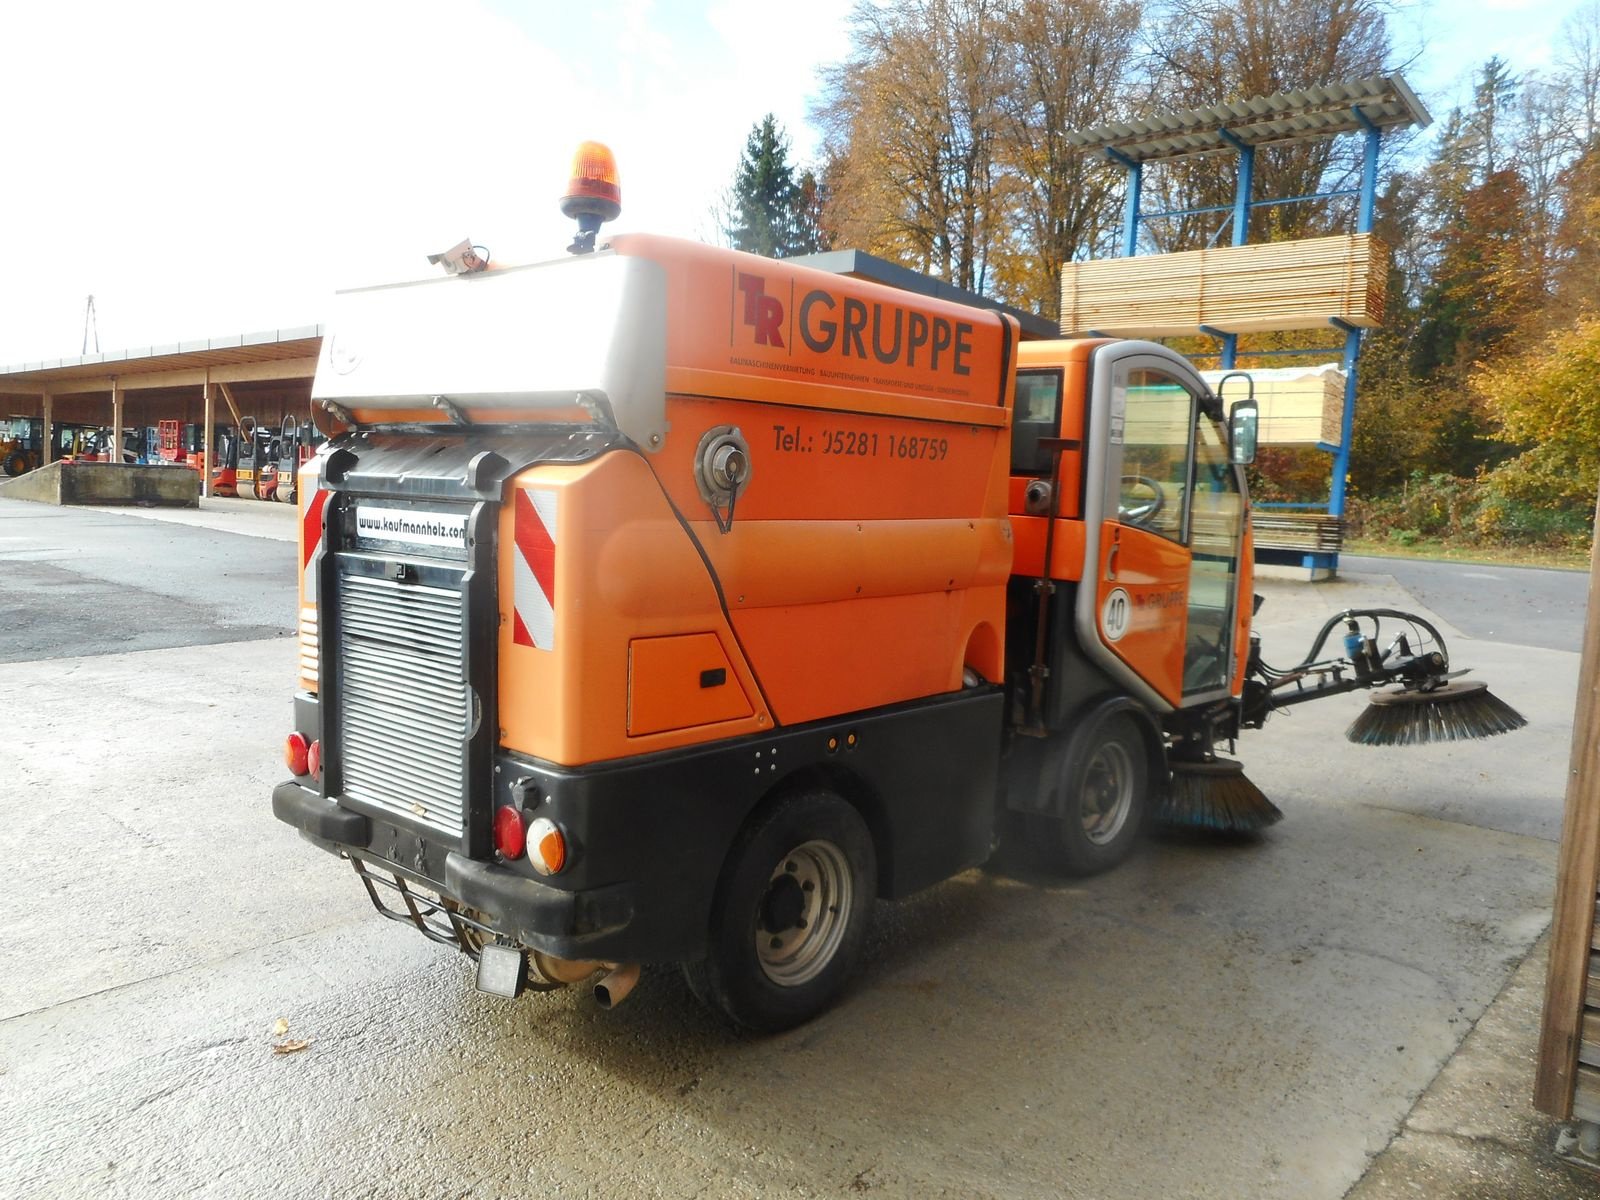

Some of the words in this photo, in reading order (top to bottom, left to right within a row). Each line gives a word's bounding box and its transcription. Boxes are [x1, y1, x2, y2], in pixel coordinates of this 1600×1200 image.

[739, 272, 785, 348] TR
[799, 289, 973, 376] GRUPPE
[773, 425, 813, 453] Tel.:
[889, 435, 948, 460] 168759
[1107, 598, 1125, 631] 40
